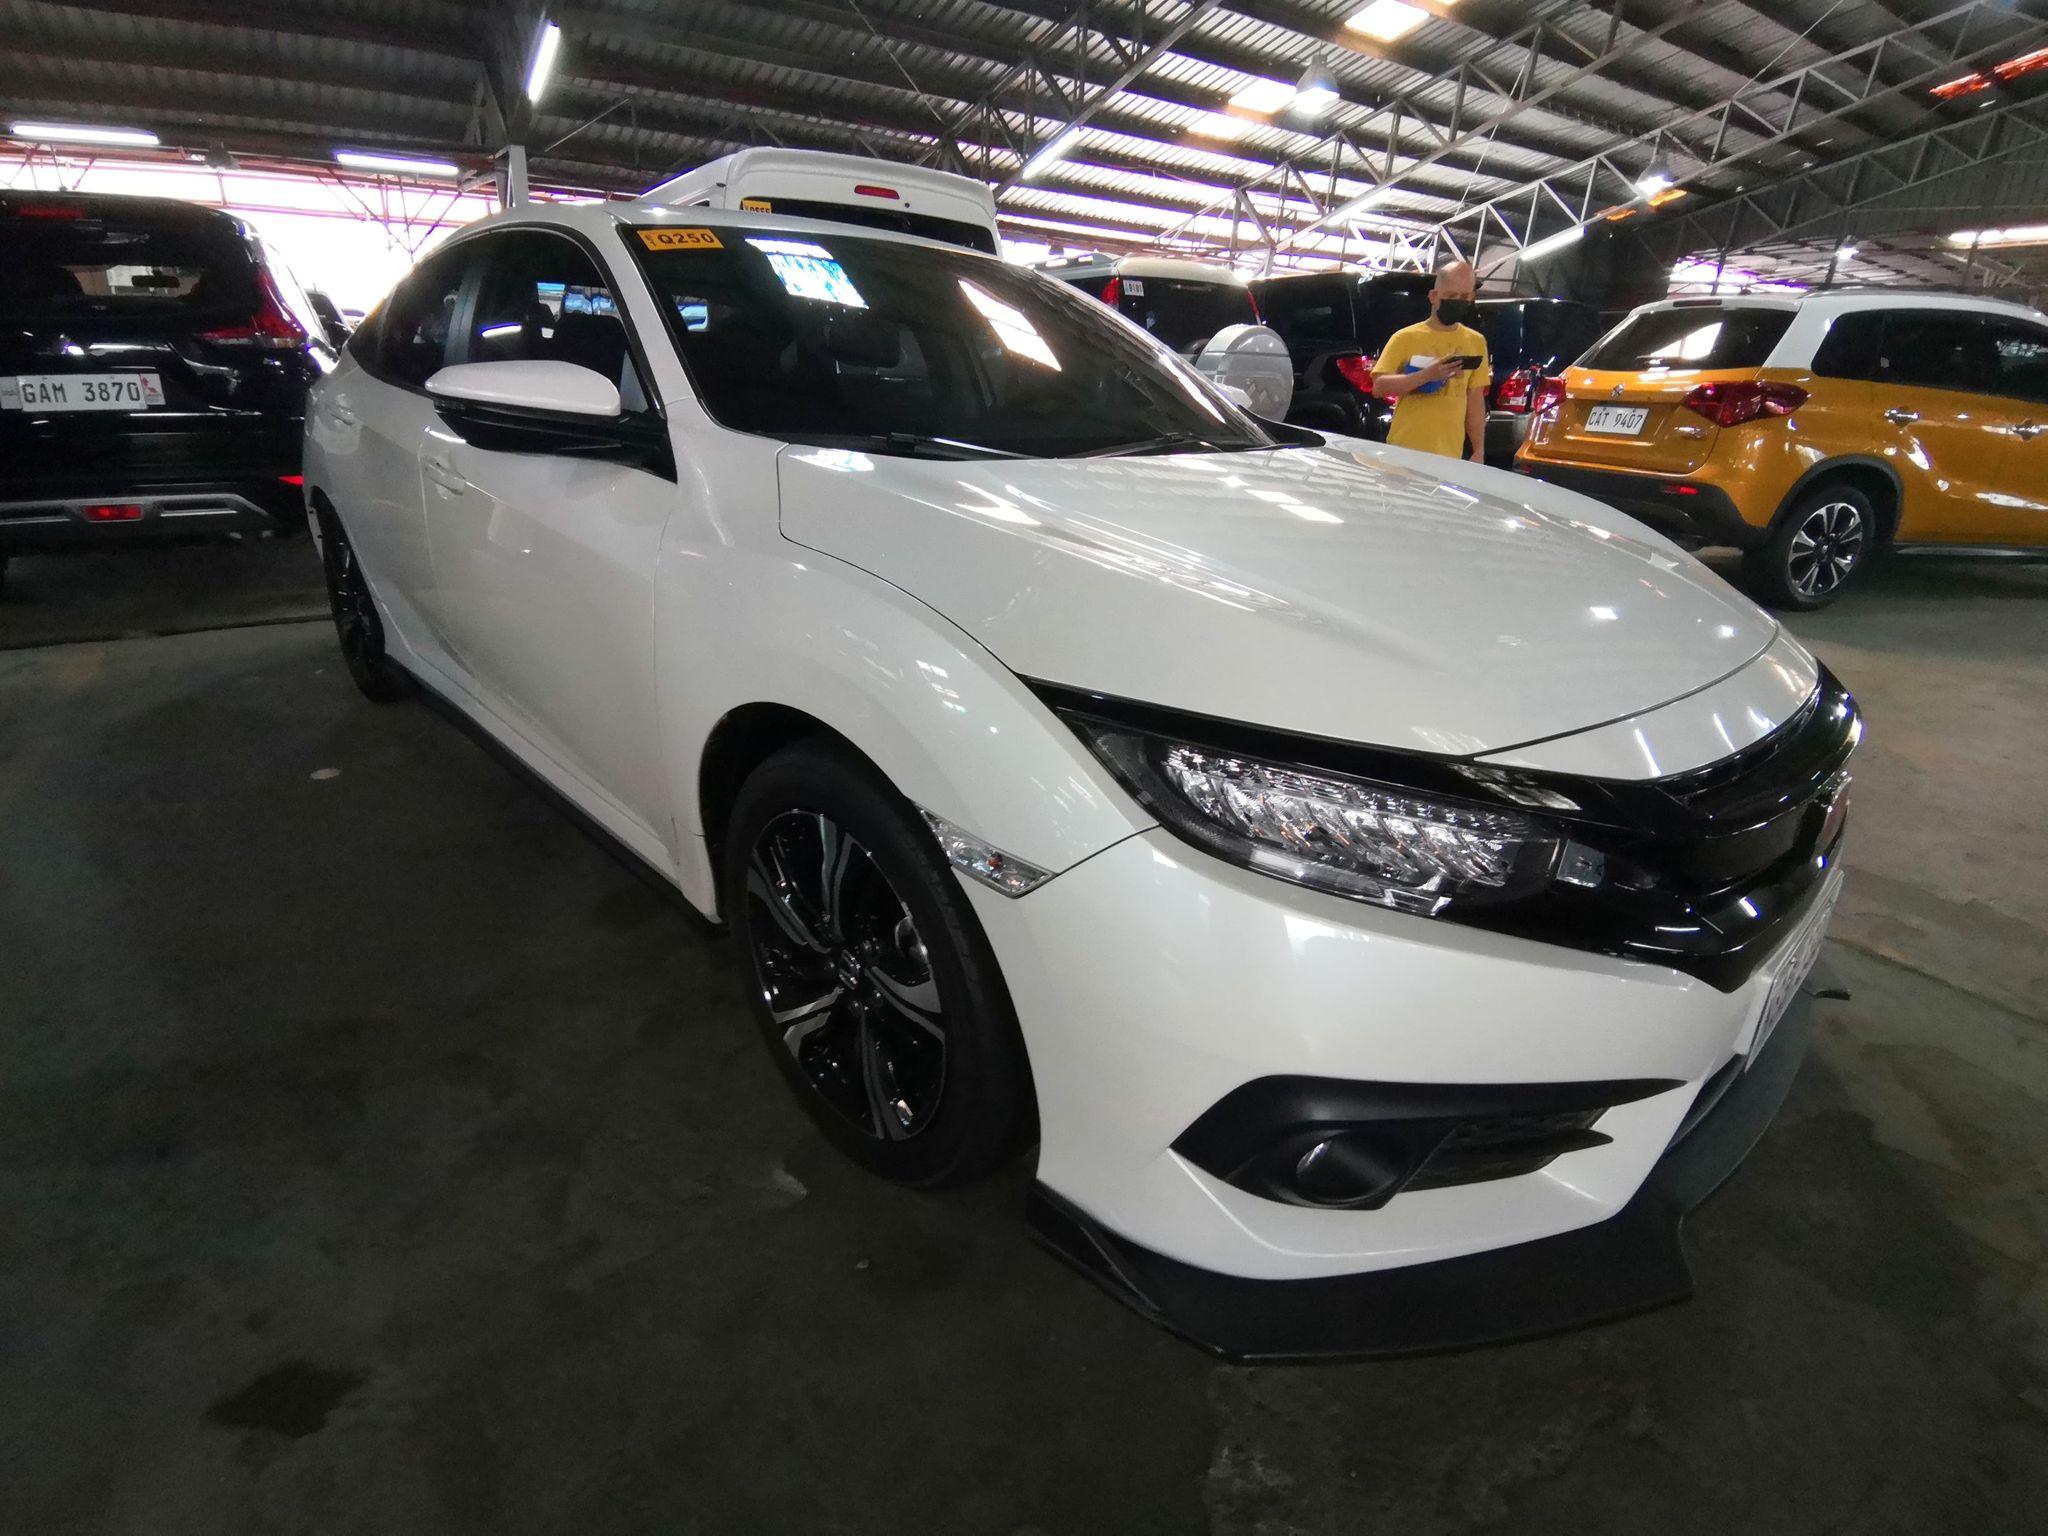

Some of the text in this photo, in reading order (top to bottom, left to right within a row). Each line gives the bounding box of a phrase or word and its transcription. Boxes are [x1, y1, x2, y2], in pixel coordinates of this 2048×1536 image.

[657, 233, 714, 245] Q250
[22, 382, 141, 403] GAM 3870
[1588, 412, 1643, 429] CAT 9407
